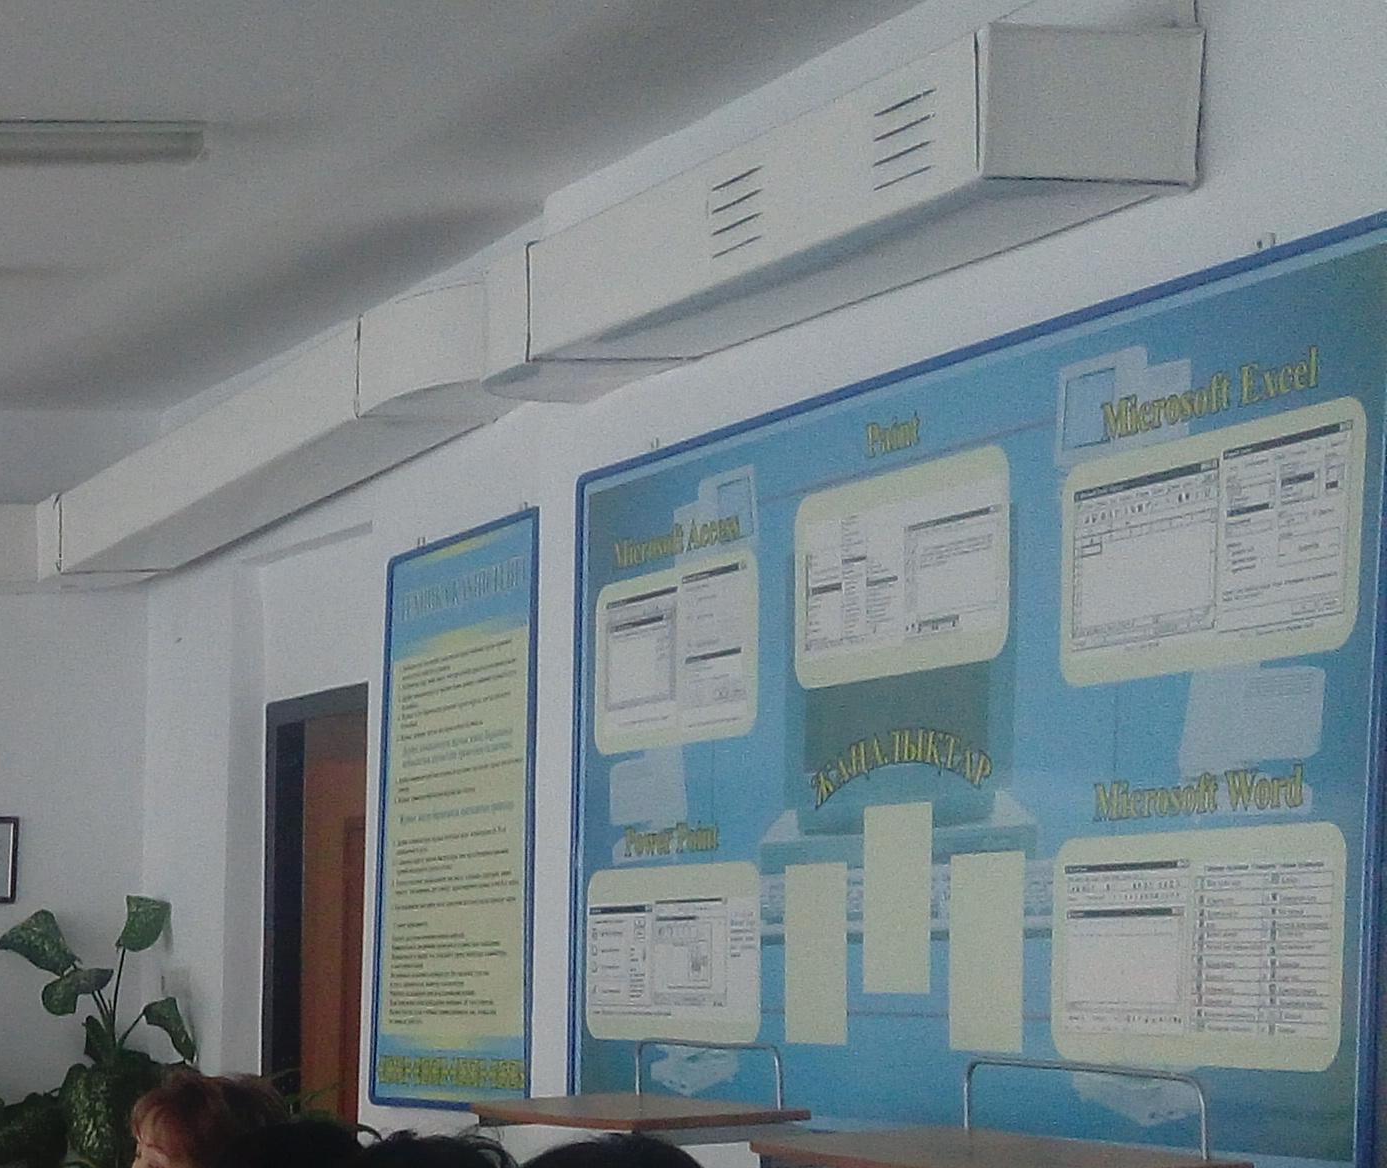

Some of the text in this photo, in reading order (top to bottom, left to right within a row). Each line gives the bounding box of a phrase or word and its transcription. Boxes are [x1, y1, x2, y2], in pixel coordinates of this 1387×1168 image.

[1101, 346, 1319, 440] Microsoft Excel
[1093, 763, 1305, 822] Microsoft Word
